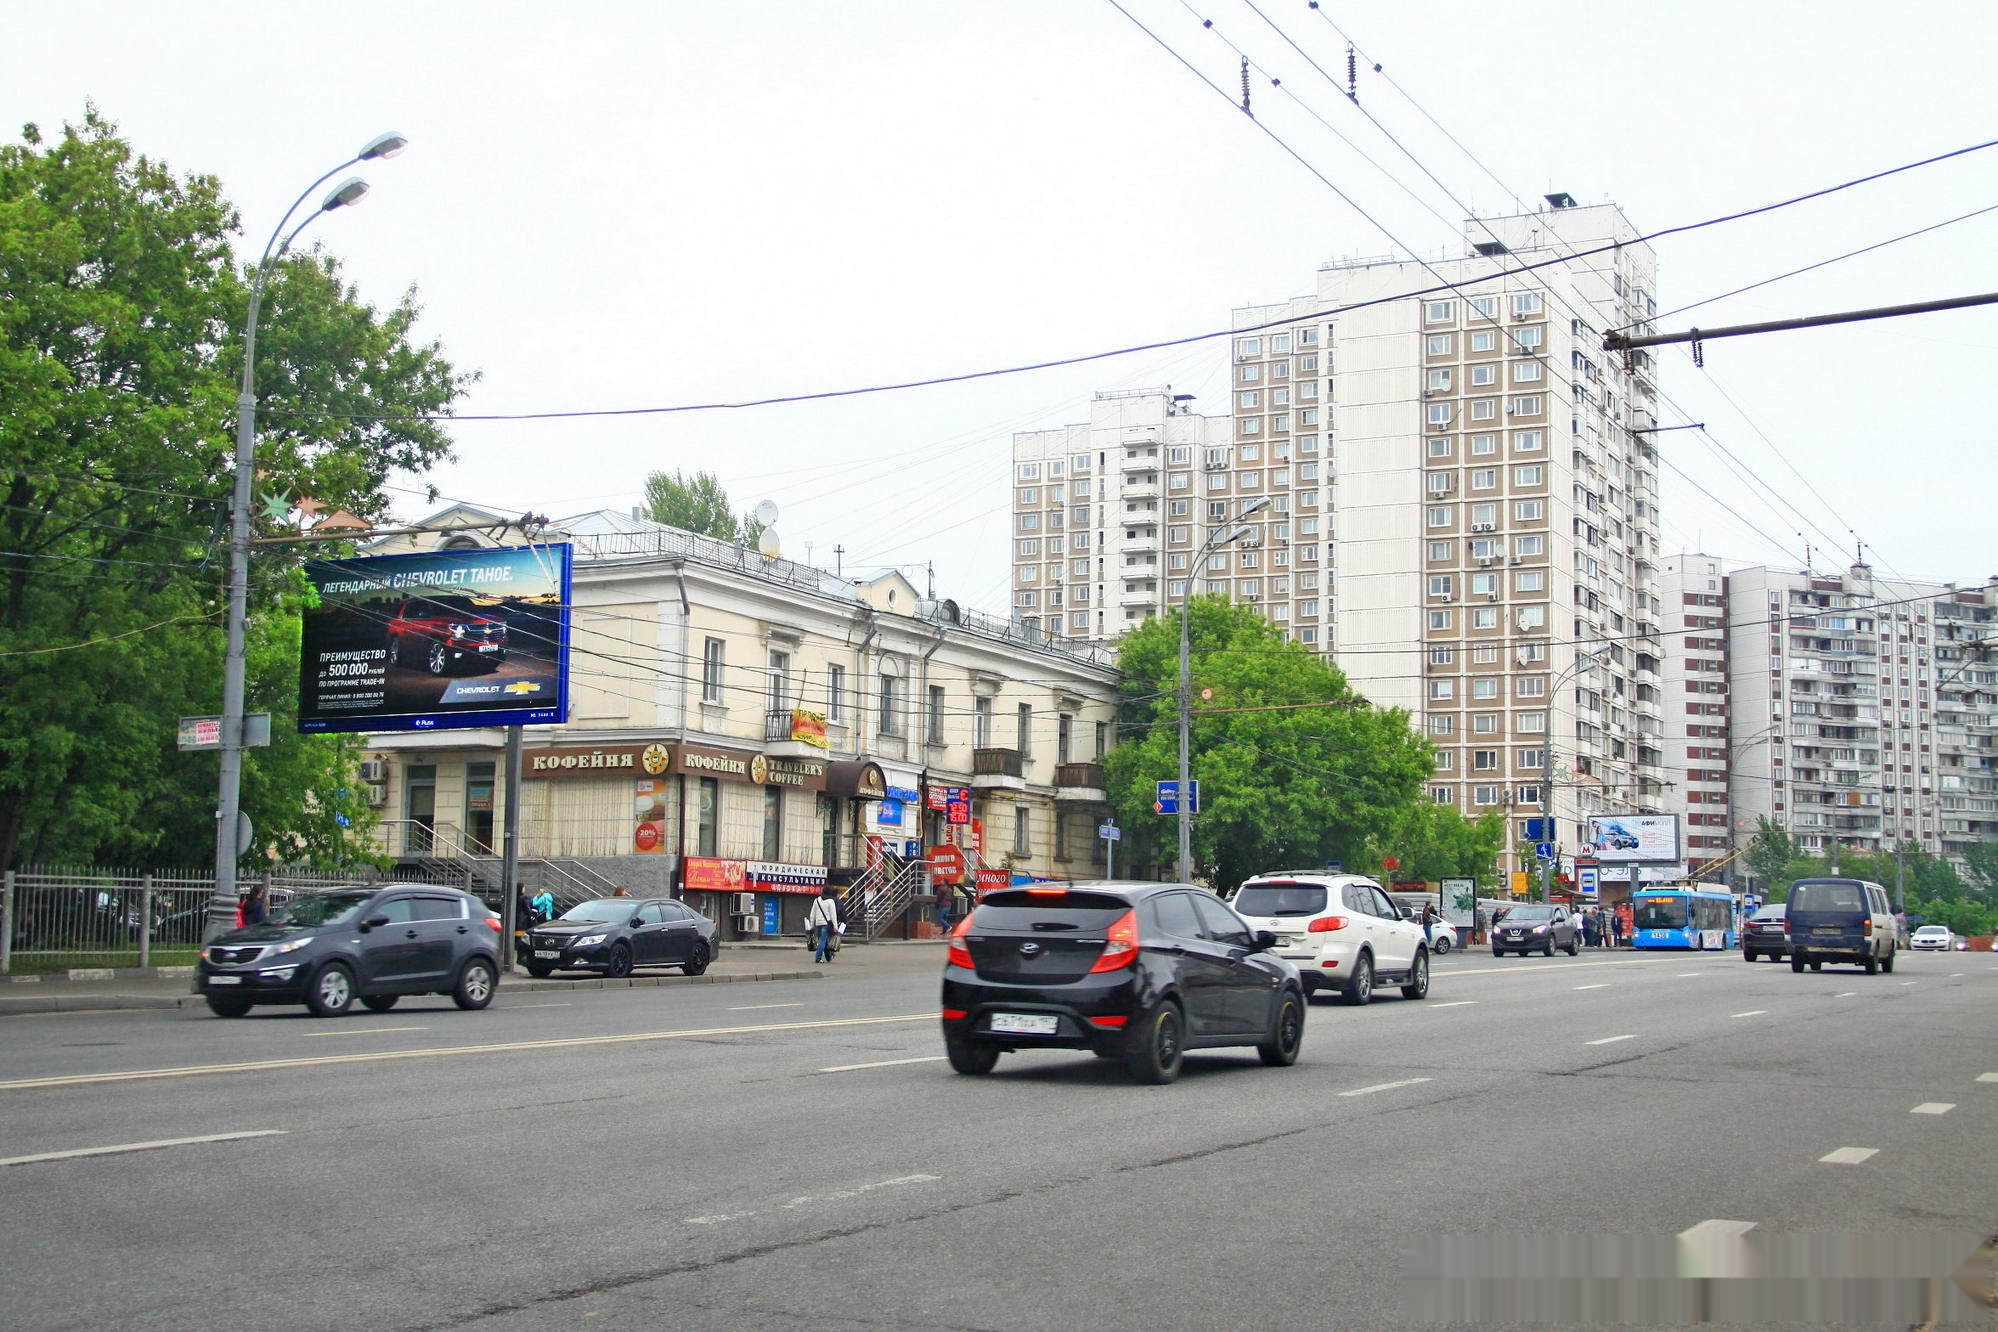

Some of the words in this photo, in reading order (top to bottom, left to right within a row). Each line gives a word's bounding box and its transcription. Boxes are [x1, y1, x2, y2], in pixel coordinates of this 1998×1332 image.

[393, 568, 467, 588] CHEVROLET
[319, 649, 386, 663] ПРЕИМУЩЕСТВО
[329, 663, 348, 676] 500
[349, 662, 369, 675] 000
[456, 685, 500, 694] CHEVROLET
[533, 751, 635, 770] КОФЕЙНЯ
[684, 753, 746, 774] КОФЕЙНЯ
[769, 760, 823, 776] TRAVELER'S
[769, 771, 804, 785] COFFEE
[761, 864, 826, 875] ЮРИДИЧЕСКАЯ
[761, 873, 826, 886] КОНСУЛЬТАЦИЯ
